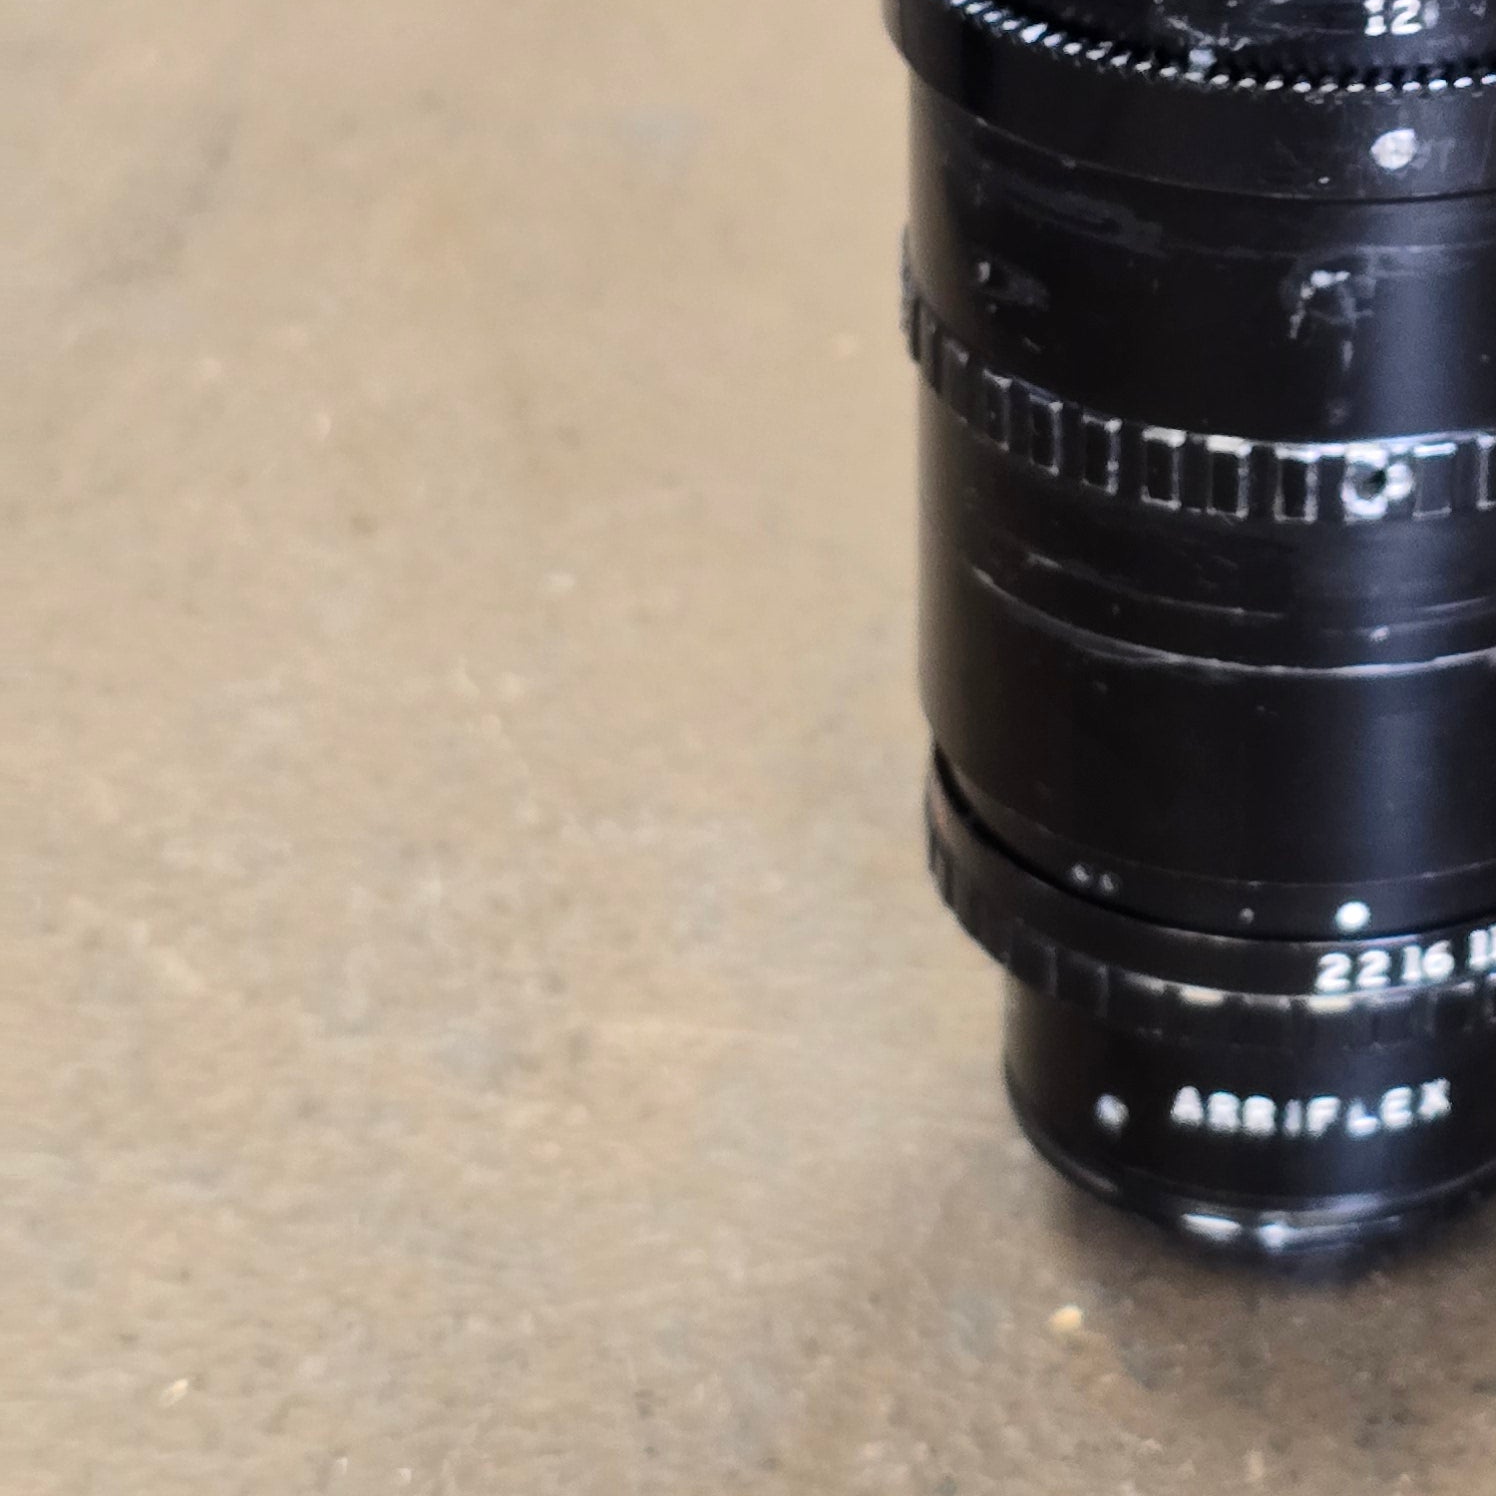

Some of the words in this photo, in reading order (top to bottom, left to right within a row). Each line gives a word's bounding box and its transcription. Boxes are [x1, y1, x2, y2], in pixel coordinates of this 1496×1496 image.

[1315, 950, 1392, 992] 22
[1402, 939, 1455, 983] 16
[1171, 1077, 1452, 1139] ARRIFLEX
